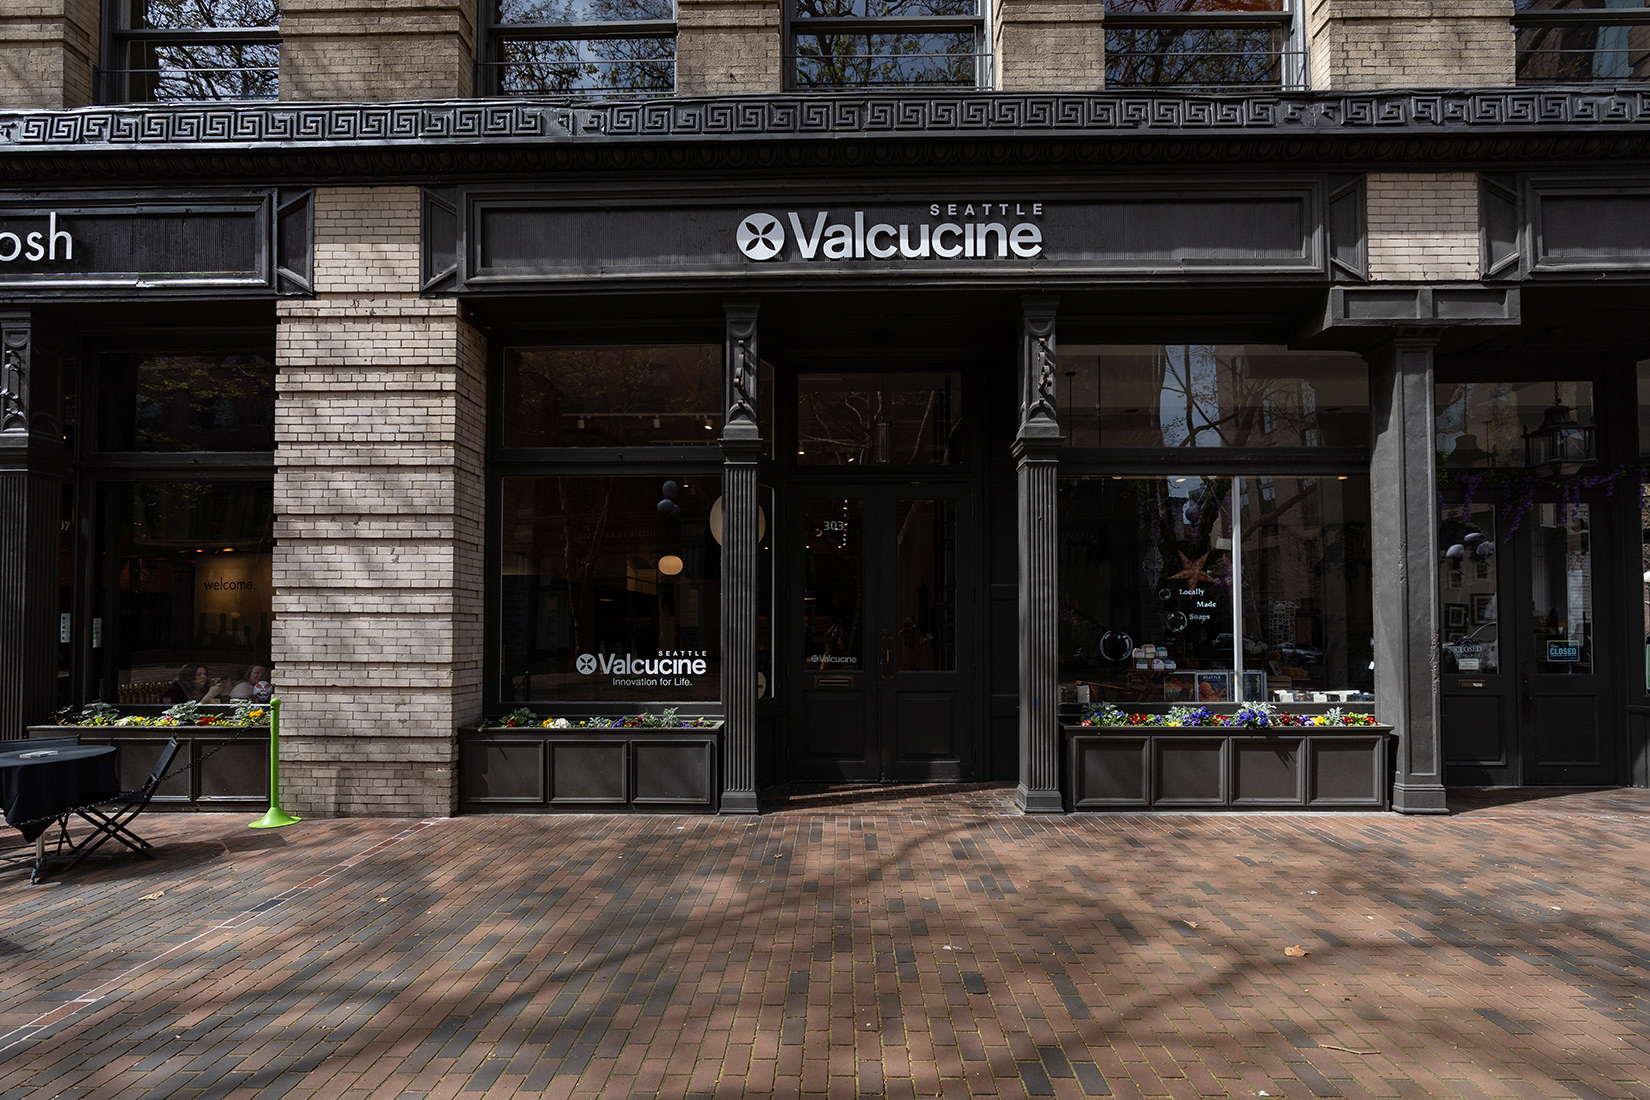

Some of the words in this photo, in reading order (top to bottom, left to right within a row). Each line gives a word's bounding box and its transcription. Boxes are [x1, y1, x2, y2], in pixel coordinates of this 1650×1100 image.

[929, 203, 1043, 216] SEATTLE
[0, 211, 73, 262] osh
[787, 210, 1043, 260] Valcucine
[823, 520, 845, 531] 303
[203, 577, 256, 591] welcome.
[1178, 588, 1205, 597] Locally
[1196, 600, 1217, 608] Made
[1188, 613, 1211, 622] Soaps
[1454, 645, 1483, 654] CLOSED
[1549, 647, 1577, 655] CLOSED
[818, 654, 857, 663] Valcucine
[597, 653, 707, 675] Valcucine
[612, 677, 658, 686] Innovation
[659, 677, 672, 686] for
[674, 677, 693, 686] Life.
